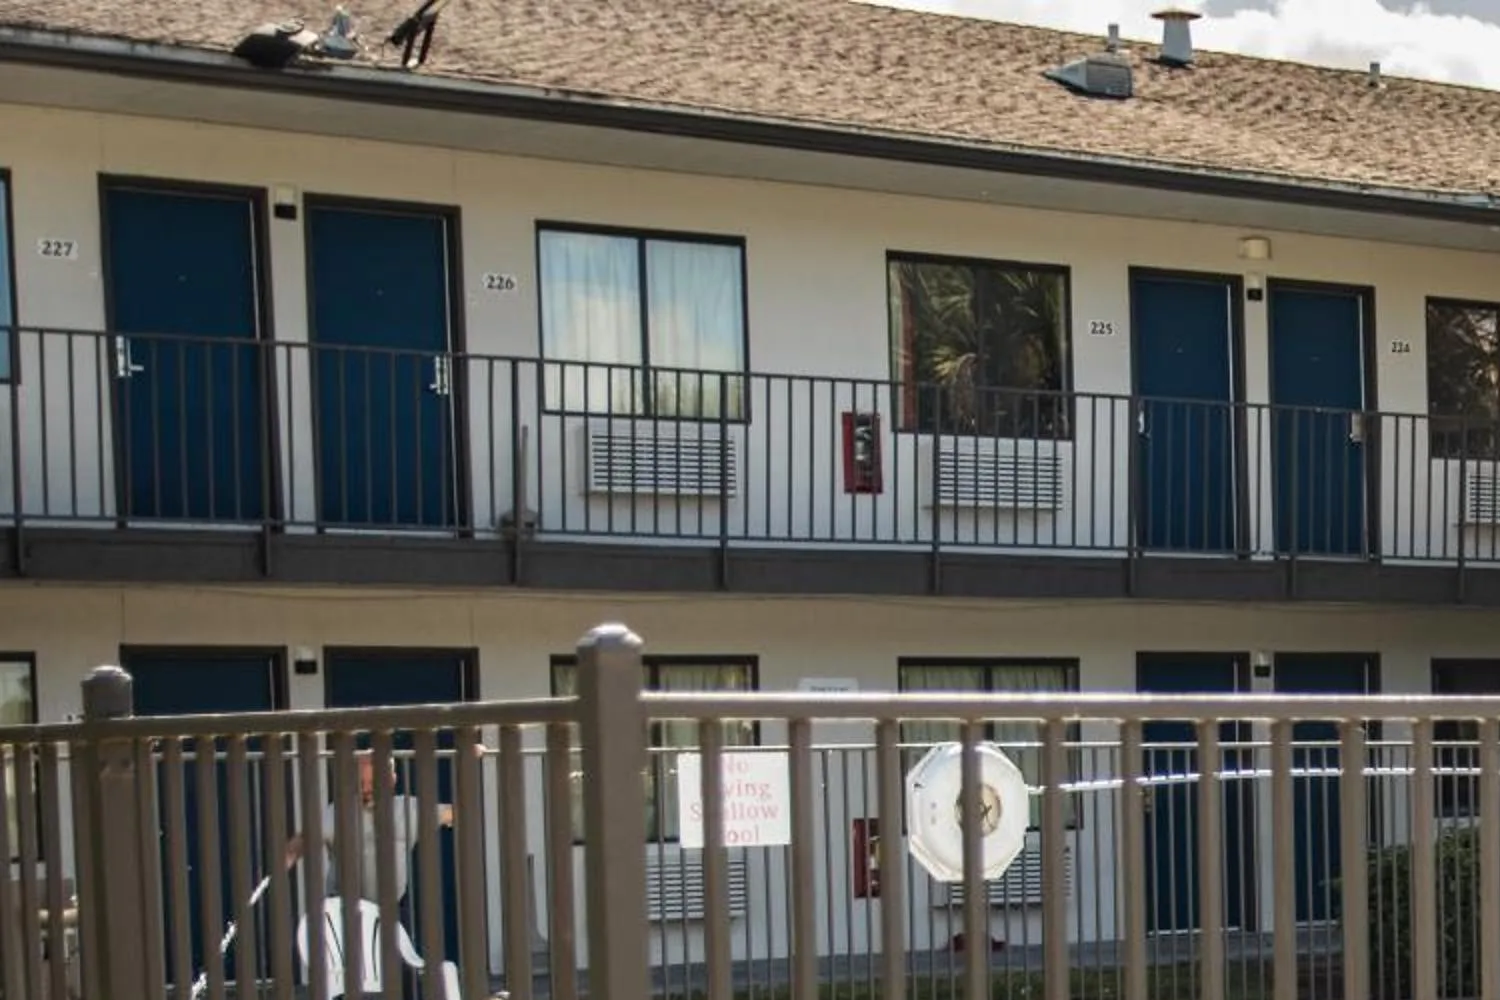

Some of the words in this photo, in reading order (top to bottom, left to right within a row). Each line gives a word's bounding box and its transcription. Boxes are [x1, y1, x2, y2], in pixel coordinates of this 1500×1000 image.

[42, 240, 73, 257] 227
[487, 274, 516, 290] 226
[1091, 321, 1113, 335] 225
[690, 801, 779, 820] Sllow
[718, 824, 759, 843] ool
